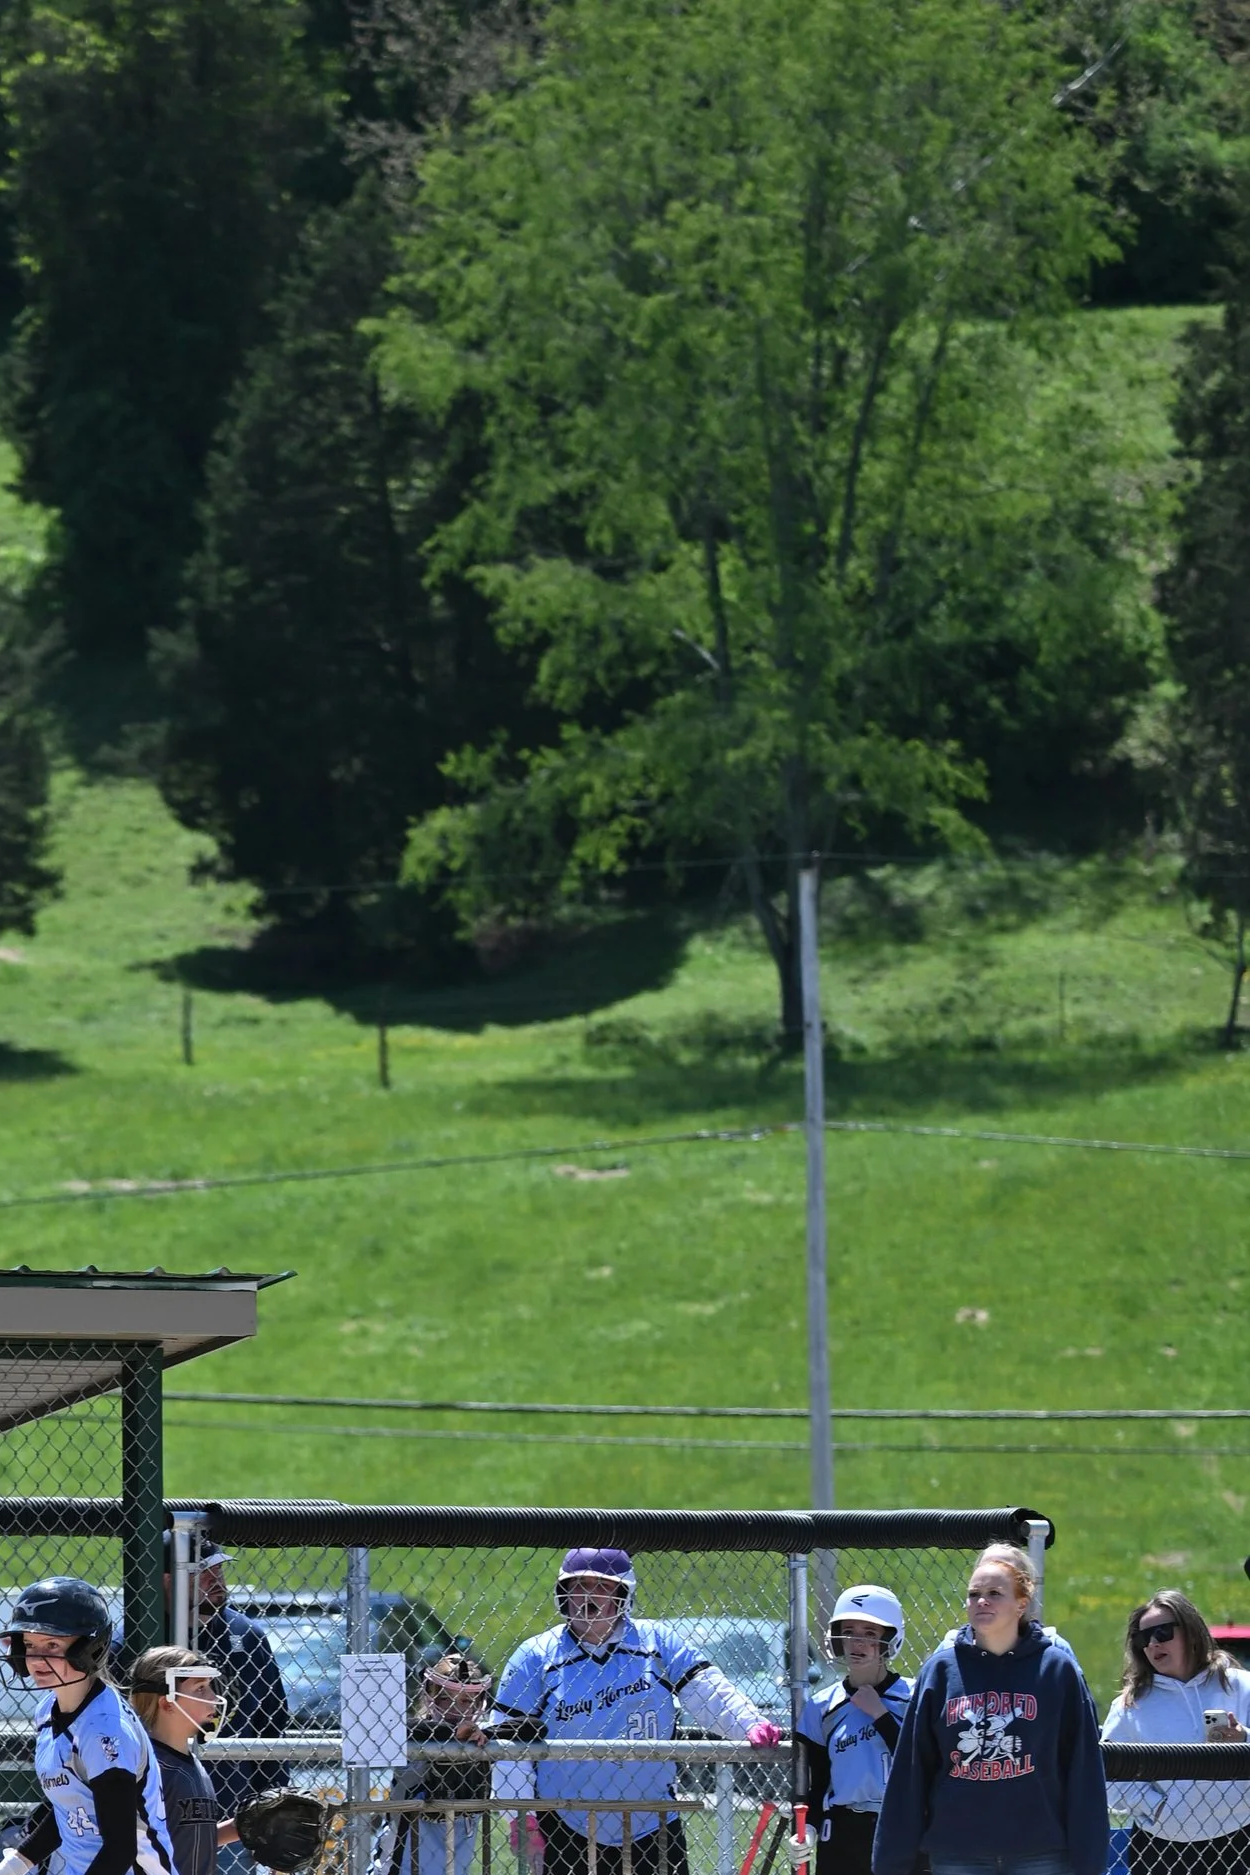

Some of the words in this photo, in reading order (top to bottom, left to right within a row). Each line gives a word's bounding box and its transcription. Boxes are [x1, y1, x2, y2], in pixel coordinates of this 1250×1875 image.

[555, 1700, 592, 1721] Lady
[595, 1678, 650, 1710] Hornets
[946, 1691, 1037, 1726] HUNDRED
[835, 1735, 858, 1753] Lady
[950, 1751, 1035, 1781] BASEBALL
